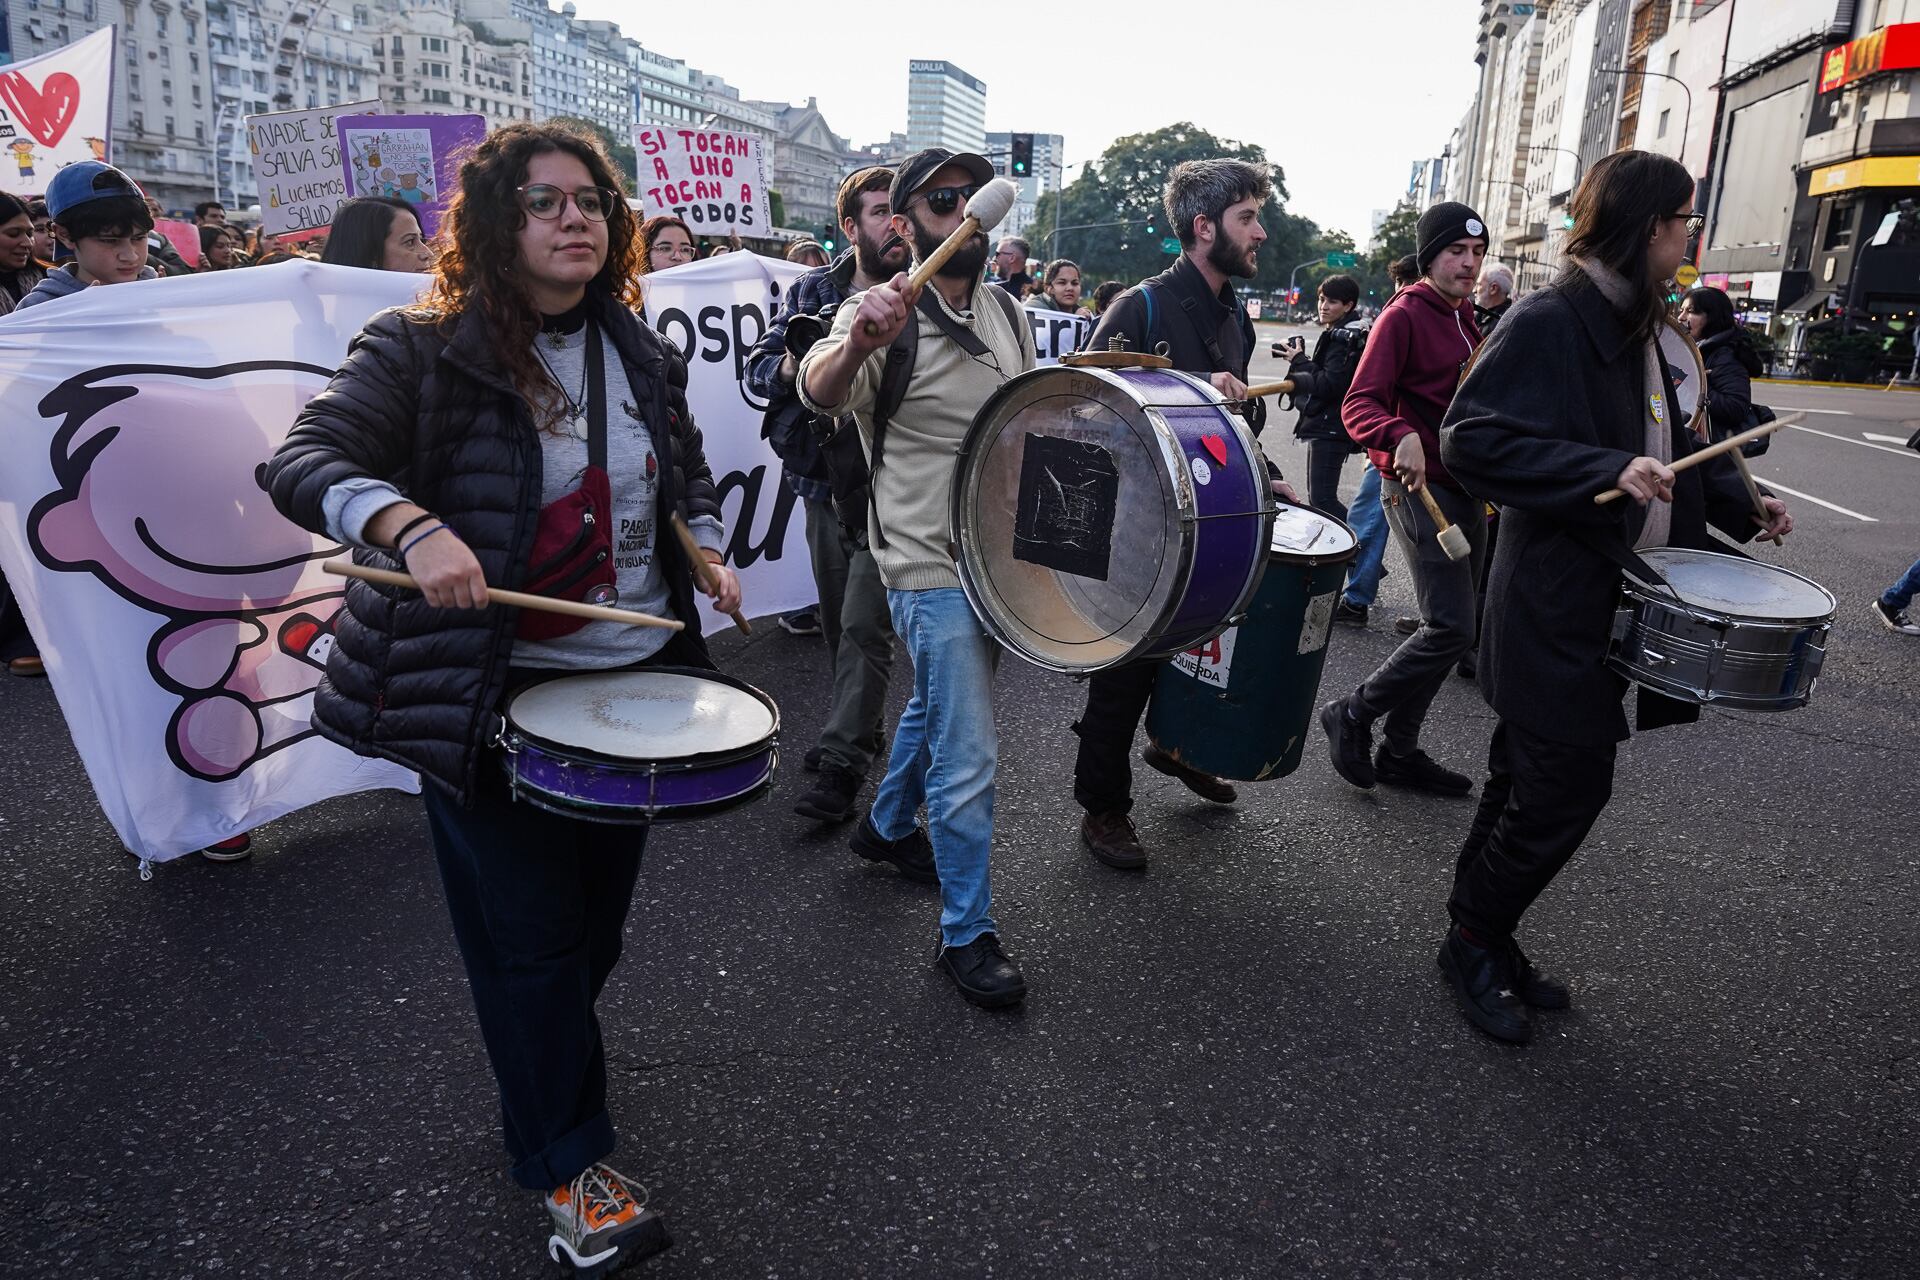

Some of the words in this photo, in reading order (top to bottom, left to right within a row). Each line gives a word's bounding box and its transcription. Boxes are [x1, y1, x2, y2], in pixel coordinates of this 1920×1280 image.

[319, 115, 337, 140] SE
[396, 132, 411, 141] EL
[640, 129, 667, 156] SI
[677, 130, 749, 158] TOCAN
[262, 149, 318, 177] SALVA
[653, 157, 669, 181] A
[647, 180, 722, 208] TOCAN
[740, 183, 752, 204] A
[286, 204, 331, 230] SALUD
[672, 202, 754, 226] TODOS
[656, 280, 785, 382] ospi
[1170, 651, 1221, 683] QUIERDA
